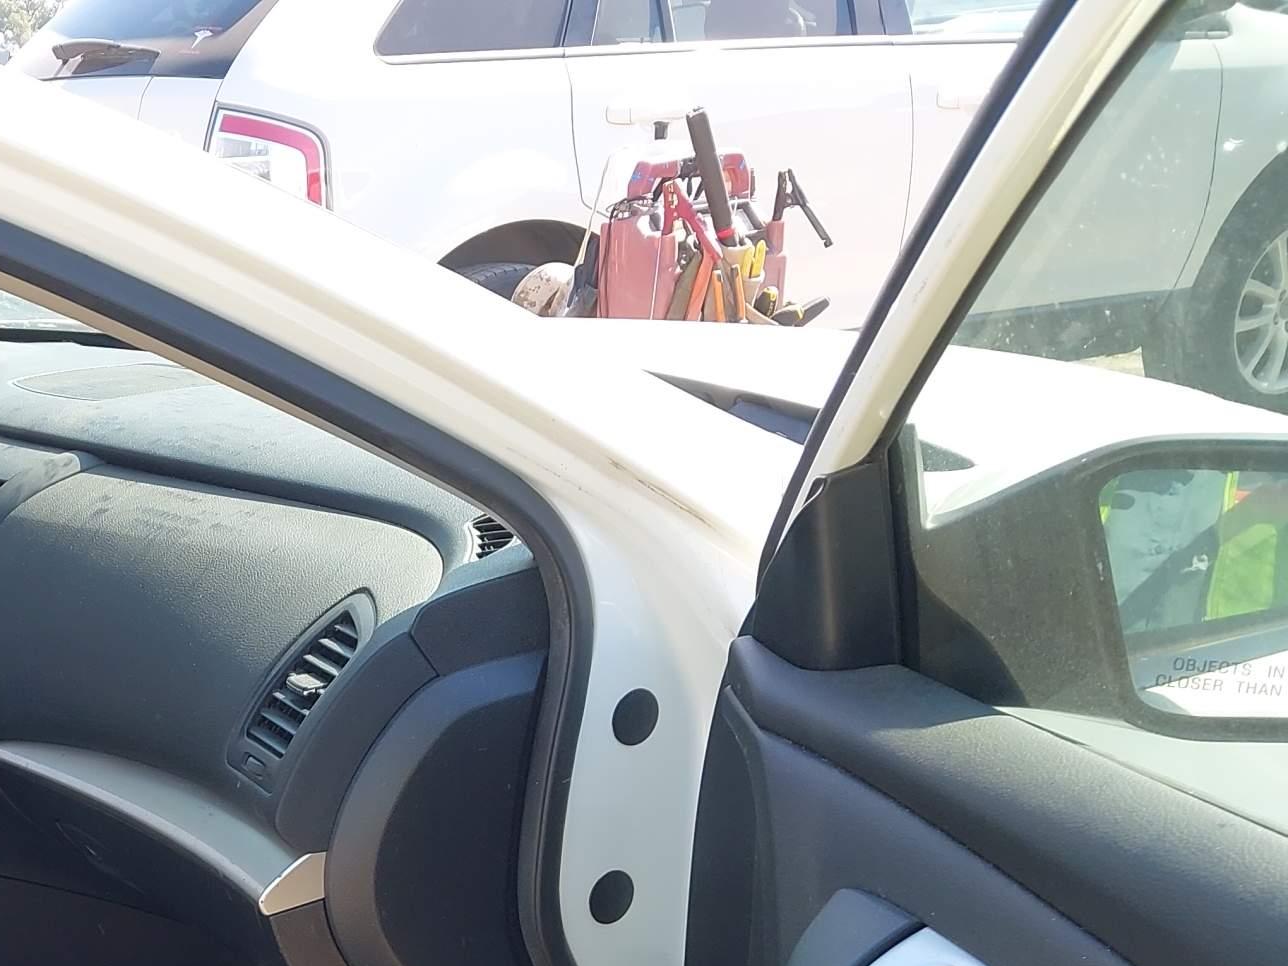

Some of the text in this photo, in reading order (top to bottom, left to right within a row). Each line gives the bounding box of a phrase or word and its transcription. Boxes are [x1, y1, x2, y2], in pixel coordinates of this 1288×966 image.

[1173, 657, 1286, 679] OBJECTS IN
[1155, 674, 1283, 697] CLOSER THAN
